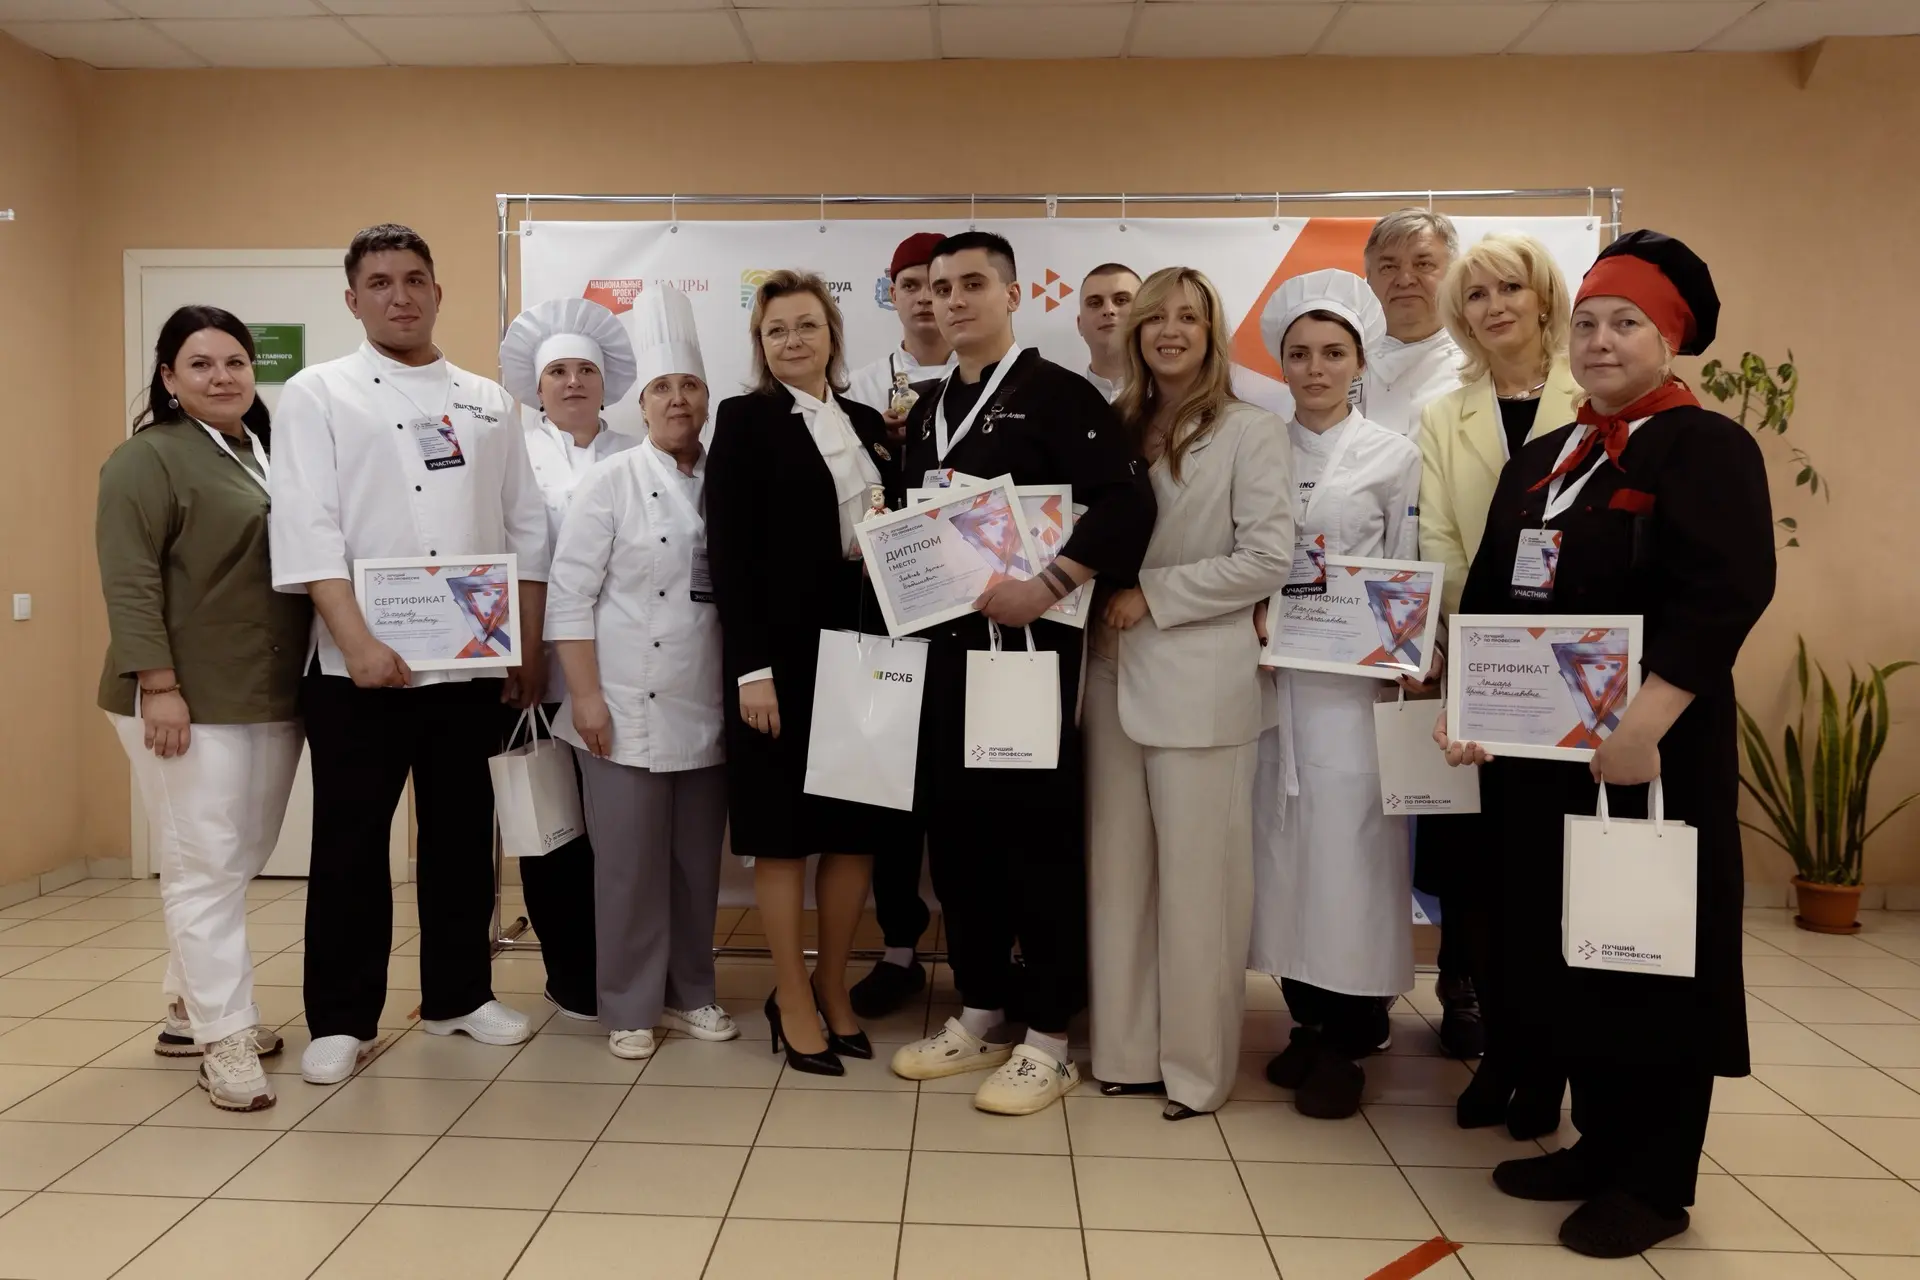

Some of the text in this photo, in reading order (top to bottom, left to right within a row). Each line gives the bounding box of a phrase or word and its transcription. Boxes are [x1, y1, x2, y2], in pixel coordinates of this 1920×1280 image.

[590, 280, 642, 289] НАЦИОНАЛЬНЫЕ
[430, 458, 462, 468] УЧАСТНИК
[885, 535, 942, 563] ДИПЛОМ
[892, 558, 917, 571] МЕСТО
[1286, 586, 1324, 594] УЧАСТНИК
[1514, 589, 1549, 599] УЧАСТНИК
[374, 595, 447, 606] СЕРТИФИКАТ
[1468, 662, 1550, 675] СЕРТИФИКАТ
[884, 671, 913, 683] РСХБ
[1601, 944, 1636, 952] ЛУЧШИЙ
[1614, 951, 1662, 960] ПРОФЕССИИ
